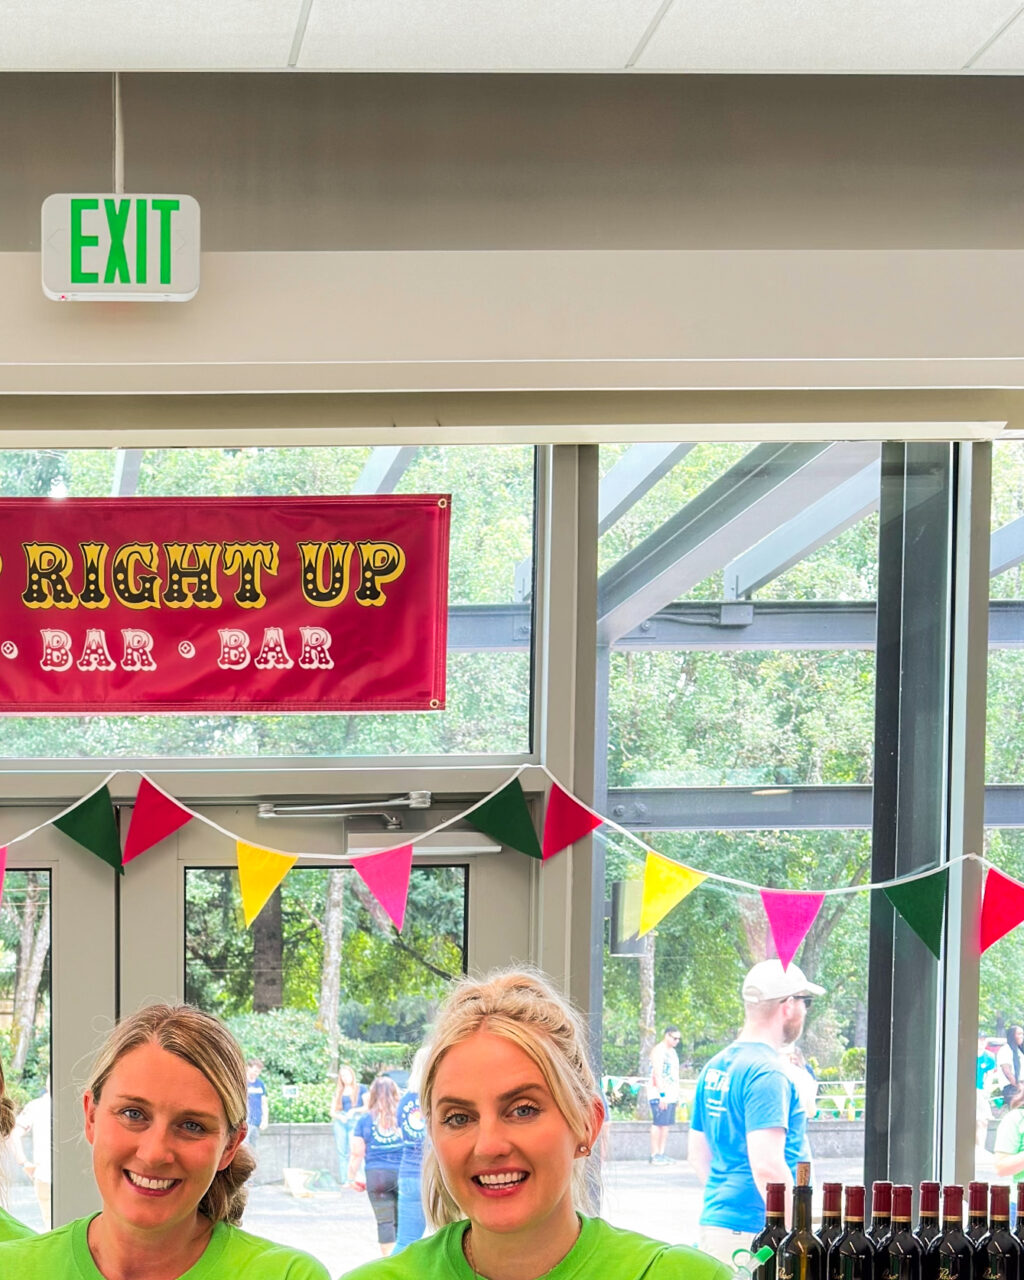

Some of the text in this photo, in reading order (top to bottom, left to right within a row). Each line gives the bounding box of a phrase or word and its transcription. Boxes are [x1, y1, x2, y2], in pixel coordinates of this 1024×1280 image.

[71, 198, 180, 284] EXIT
[21, 541, 280, 610] RIGHT
[296, 540, 406, 608] UP
[40, 628, 157, 671] BAR
[217, 626, 334, 670] BAR
